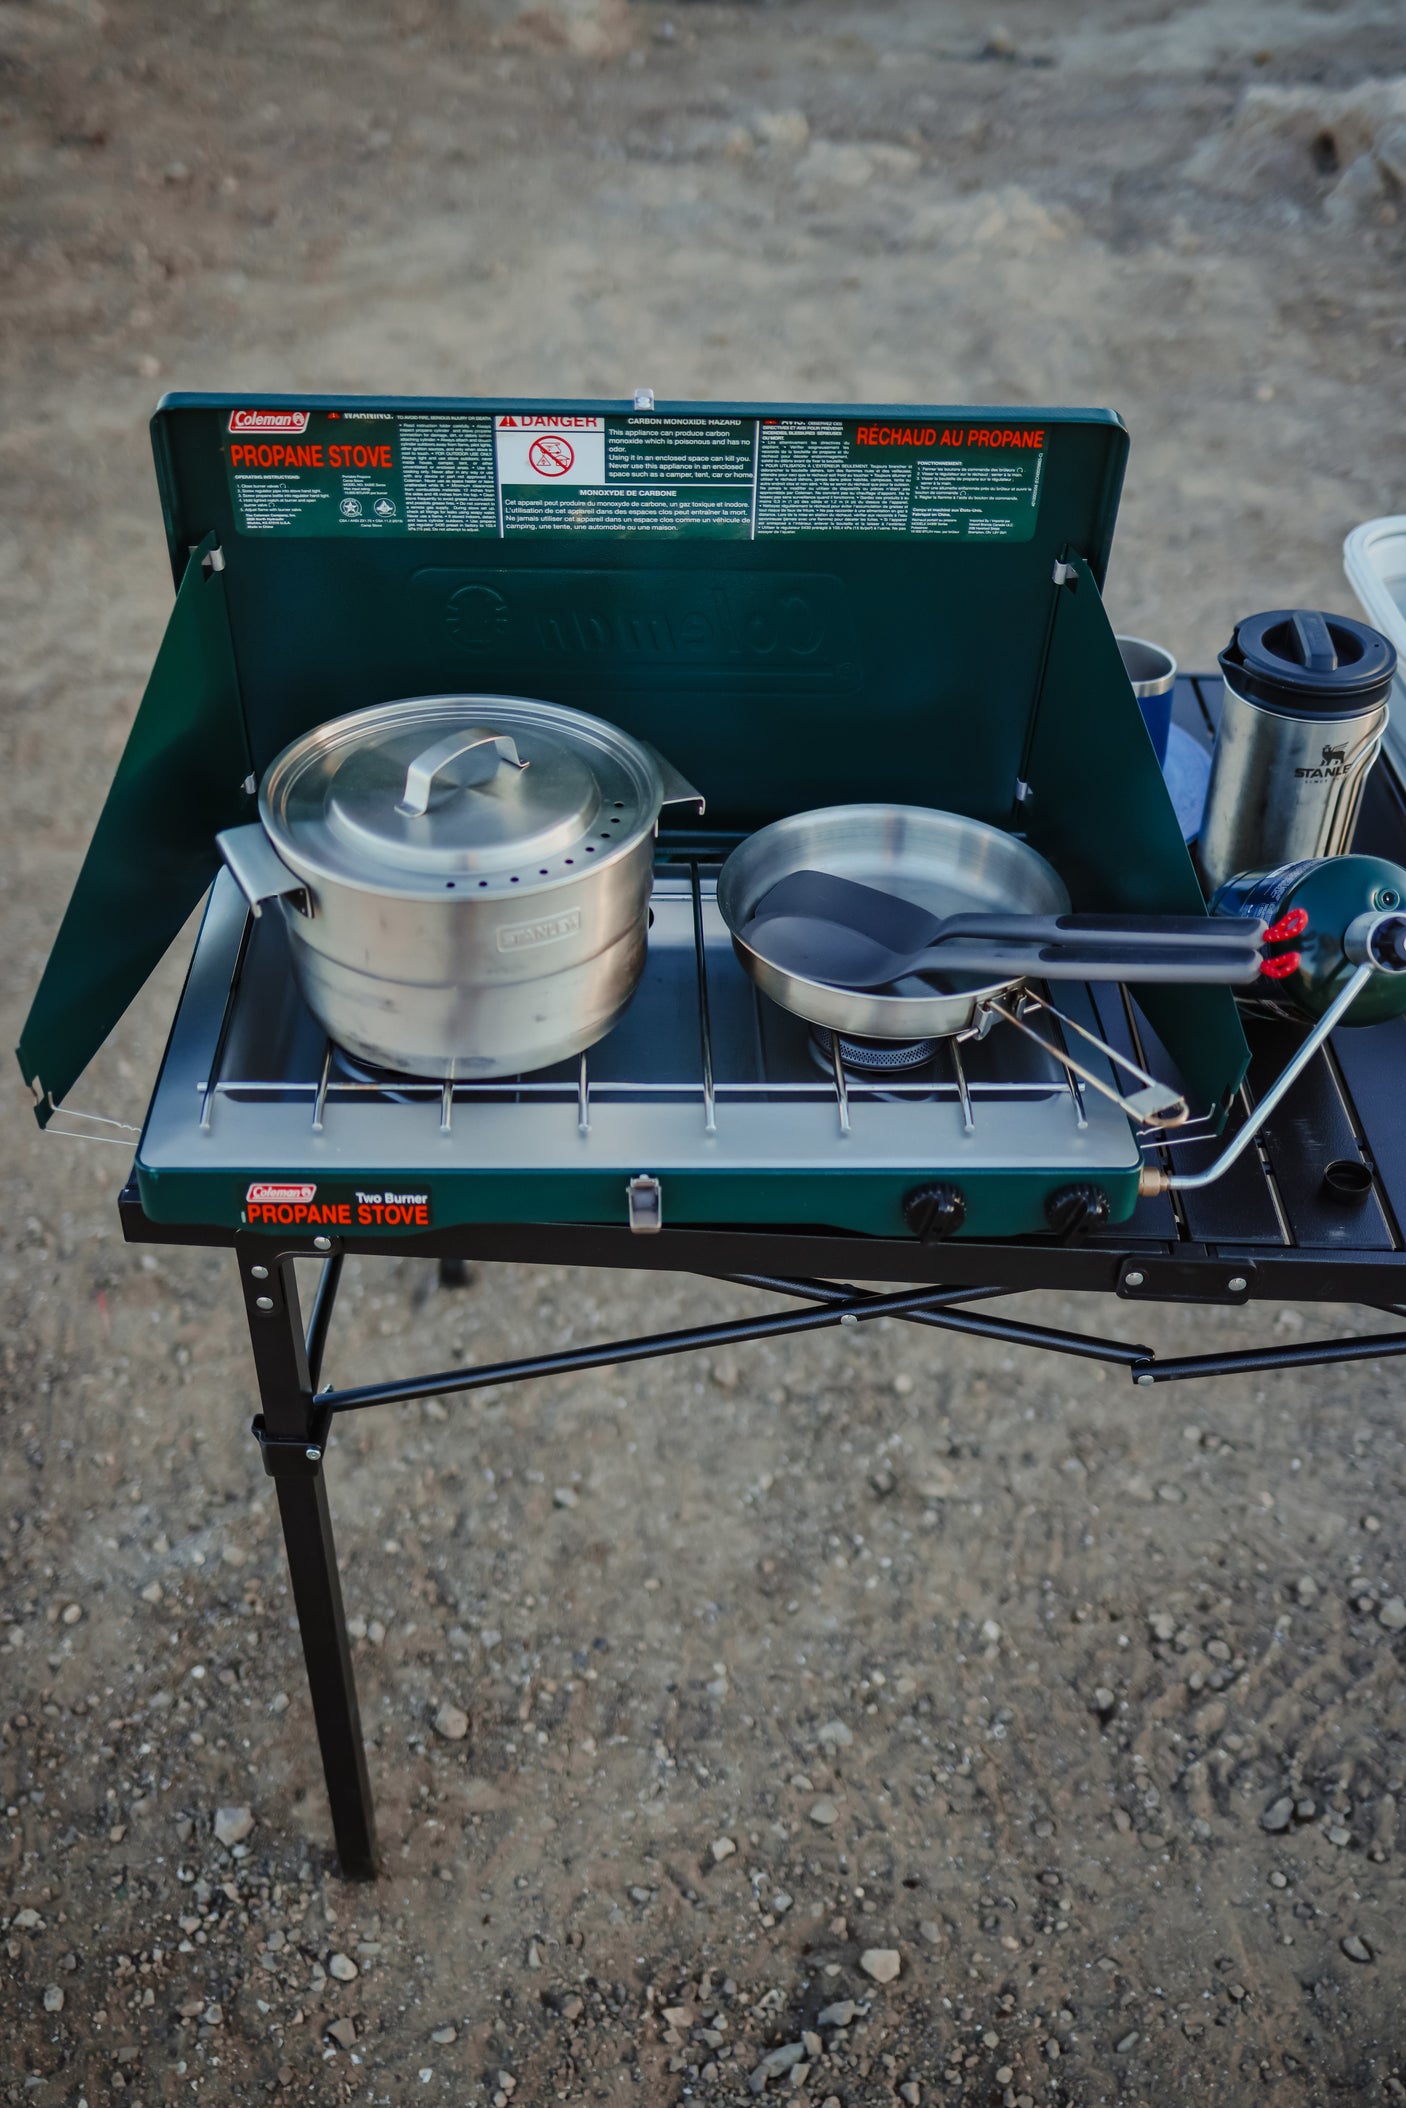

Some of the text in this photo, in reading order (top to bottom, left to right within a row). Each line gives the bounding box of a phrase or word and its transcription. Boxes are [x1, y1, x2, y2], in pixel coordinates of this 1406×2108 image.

[236, 411, 290, 426] Coleman
[522, 416, 598, 428] DANGER
[625, 430, 659, 438] appliance
[674, 430, 704, 438] produce
[856, 423, 936, 446] RÉCHAUD
[939, 428, 962, 447] AU
[968, 430, 1044, 448] PROPANE
[674, 438, 711, 446] poisonous
[230, 445, 392, 468] PROPANE STOVE
[609, 455, 629, 463] Using
[659, 463, 693, 471] appliance
[694, 471, 710, 479] tent,
[517, 499, 543, 507] appareil
[544, 499, 558, 507] peut
[559, 499, 586, 508] produire
[597, 500, 630, 508] monoxyde
[640, 500, 668, 508] carbone,
[692, 500, 715, 508] toxique
[567, 508, 595, 516] appareil
[674, 509, 690, 517] peut
[517, 515, 539, 523] jamais
[576, 516, 604, 524] appareil
[506, 523, 537, 531] camping,
[553, 523, 572, 531] tente,
[1294, 764, 1352, 778] STANLE
[252, 1186, 304, 1198] Coleman
[355, 1192, 428, 1204] Two Burner
[247, 1204, 429, 1224] PROPANE STOVE
